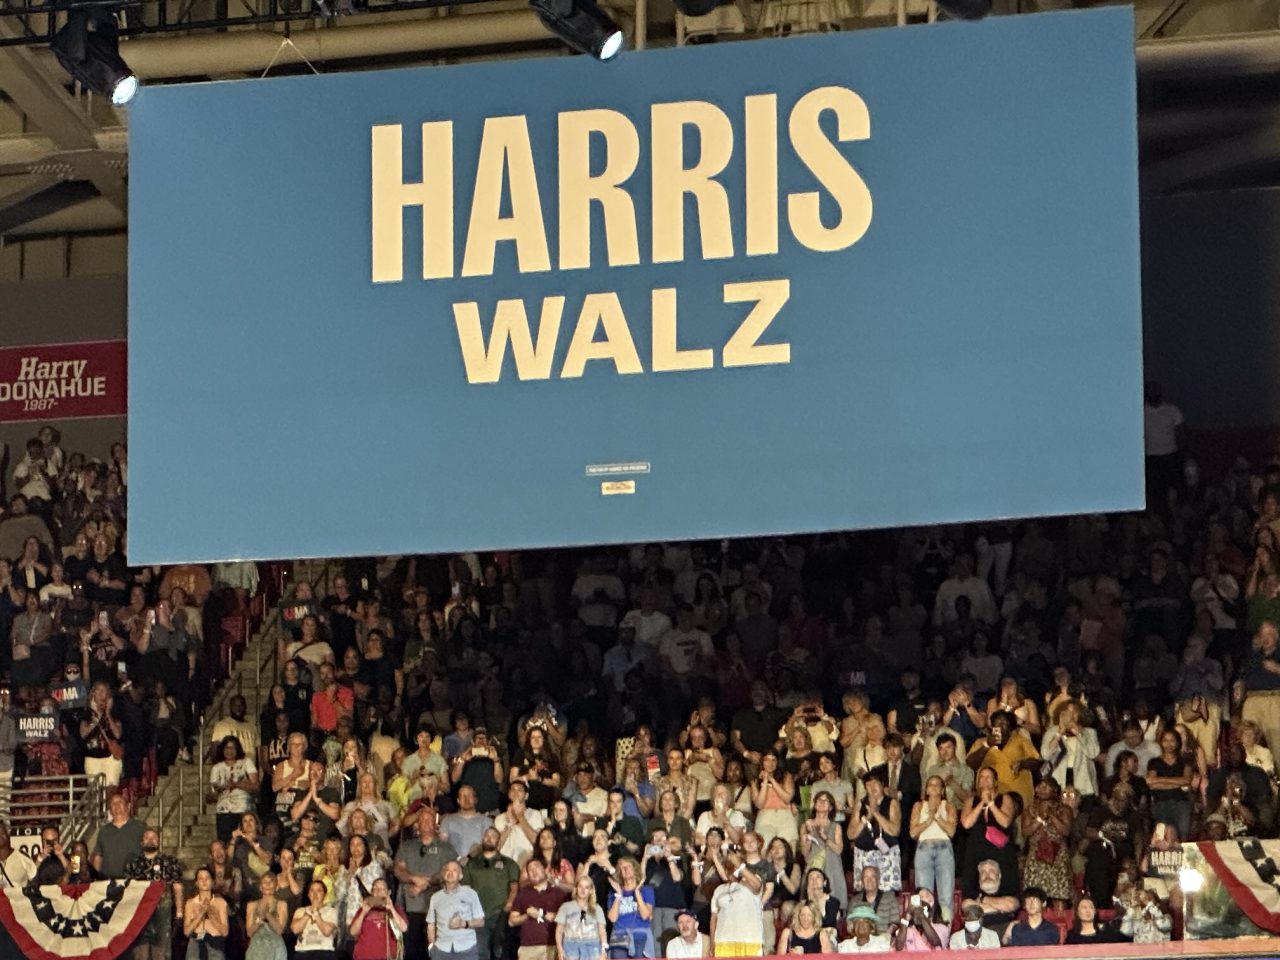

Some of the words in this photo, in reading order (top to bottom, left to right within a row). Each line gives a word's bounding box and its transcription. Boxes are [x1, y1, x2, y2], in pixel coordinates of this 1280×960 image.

[372, 86, 873, 283] HARRIS
[453, 279, 791, 384] WALZ
[18, 357, 88, 382] Harry
[19, 717, 55, 730] HARRIS
[25, 730, 49, 738] WALZ
